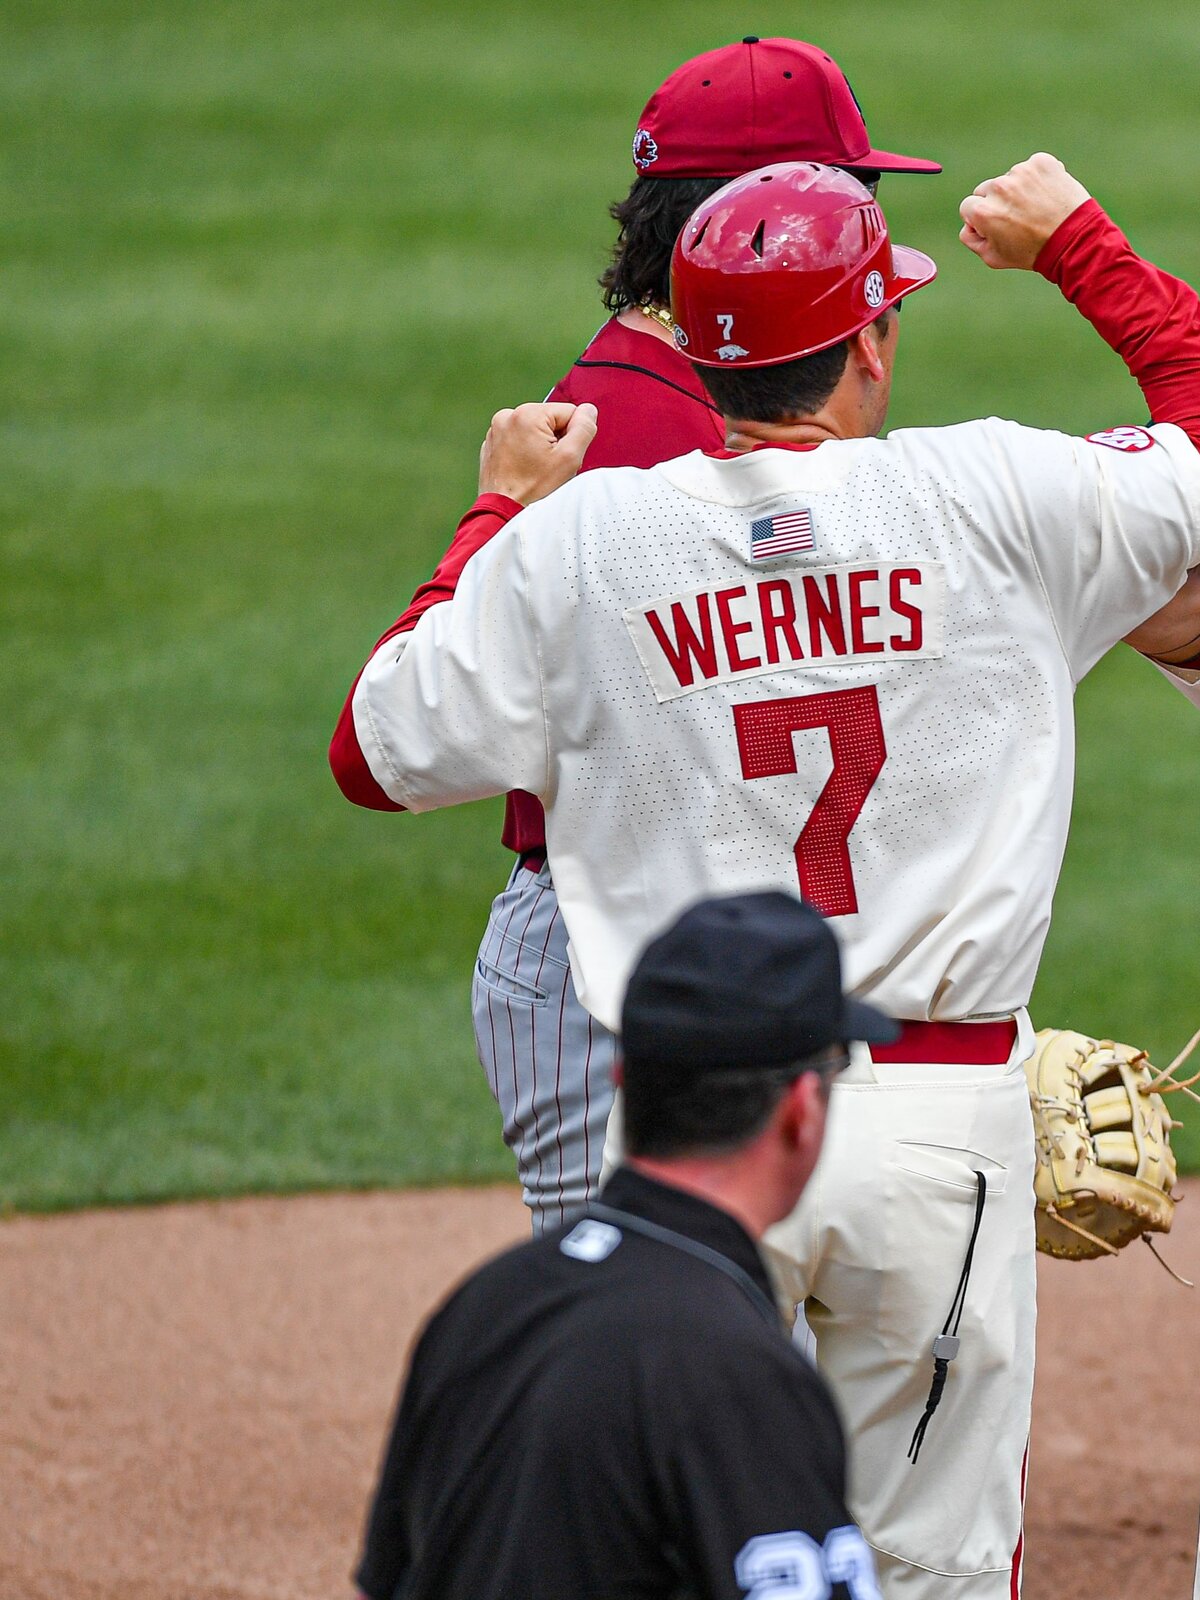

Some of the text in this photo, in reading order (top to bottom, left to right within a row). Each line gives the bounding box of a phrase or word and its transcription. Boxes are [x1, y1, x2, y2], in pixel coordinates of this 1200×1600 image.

[716, 313, 734, 341] 7
[643, 567, 923, 688] WERNES
[731, 684, 888, 919] 7
